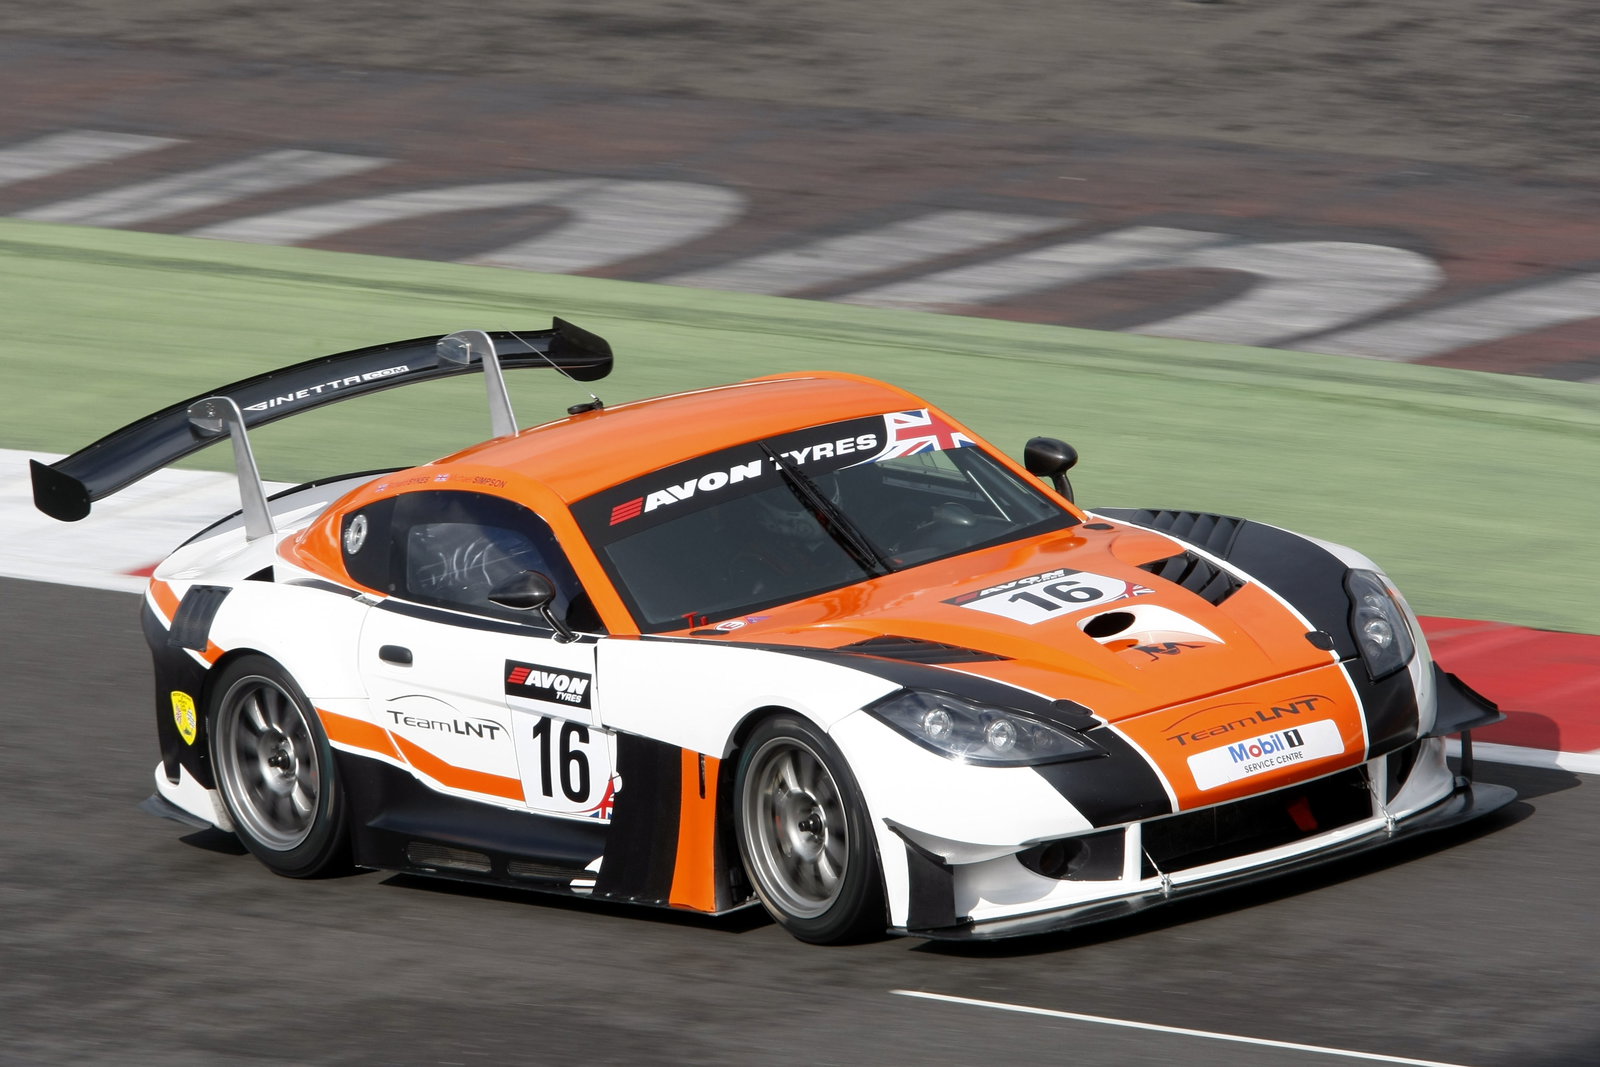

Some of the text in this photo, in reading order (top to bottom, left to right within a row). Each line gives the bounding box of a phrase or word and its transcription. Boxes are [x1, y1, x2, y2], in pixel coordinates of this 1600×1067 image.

[243, 375, 361, 411] GINETTA
[472, 476, 508, 489] SIMPSON
[643, 459, 763, 513] AVON
[979, 568, 1065, 597] AVON
[1007, 580, 1104, 612] 16
[524, 669, 590, 696] AVON
[555, 691, 583, 704] TYRES
[532, 715, 591, 804] 16
[1227, 730, 1303, 764] Mobil 1
[1243, 750, 1304, 774] SERVICE CENTRE
